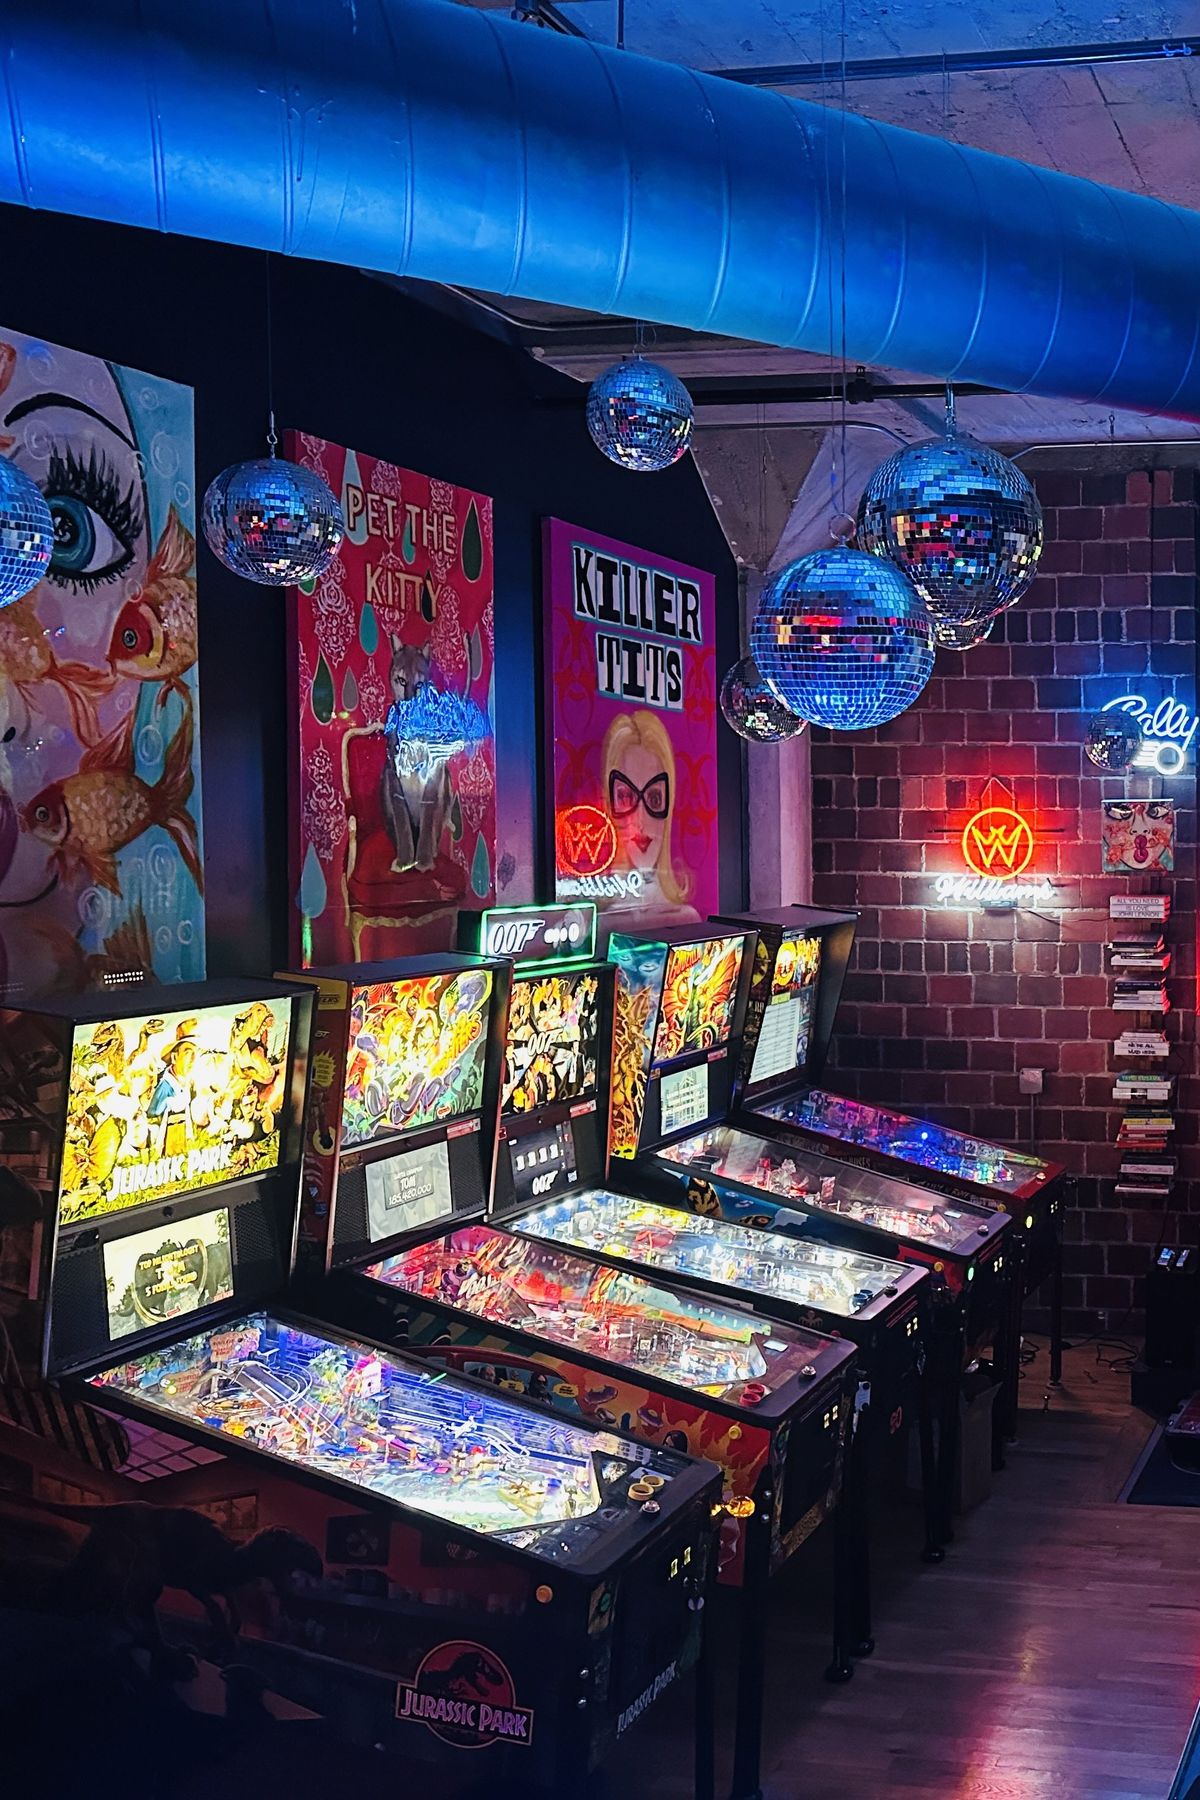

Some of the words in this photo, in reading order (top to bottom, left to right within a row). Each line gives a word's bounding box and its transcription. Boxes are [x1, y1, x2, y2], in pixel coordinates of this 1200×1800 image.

[346, 484, 397, 538] PET
[406, 504, 456, 555] THE
[365, 563, 442, 618] KITTY
[572, 546, 702, 642] KILLER
[597, 633, 682, 702] TITS
[929, 875, 1057, 902] Williams
[487, 919, 546, 956] 007
[527, 1027, 564, 1057] 007
[105, 1154, 184, 1202] JURASSIC
[186, 1142, 233, 1180] PARK
[400, 1175, 417, 1192] TOM
[532, 1170, 559, 1196] 007
[400, 1688, 477, 1728] JURASSIC
[478, 1703, 528, 1738] PARK
[615, 1683, 654, 1740] JURASSIC
[652, 1659, 678, 1702] PARK
